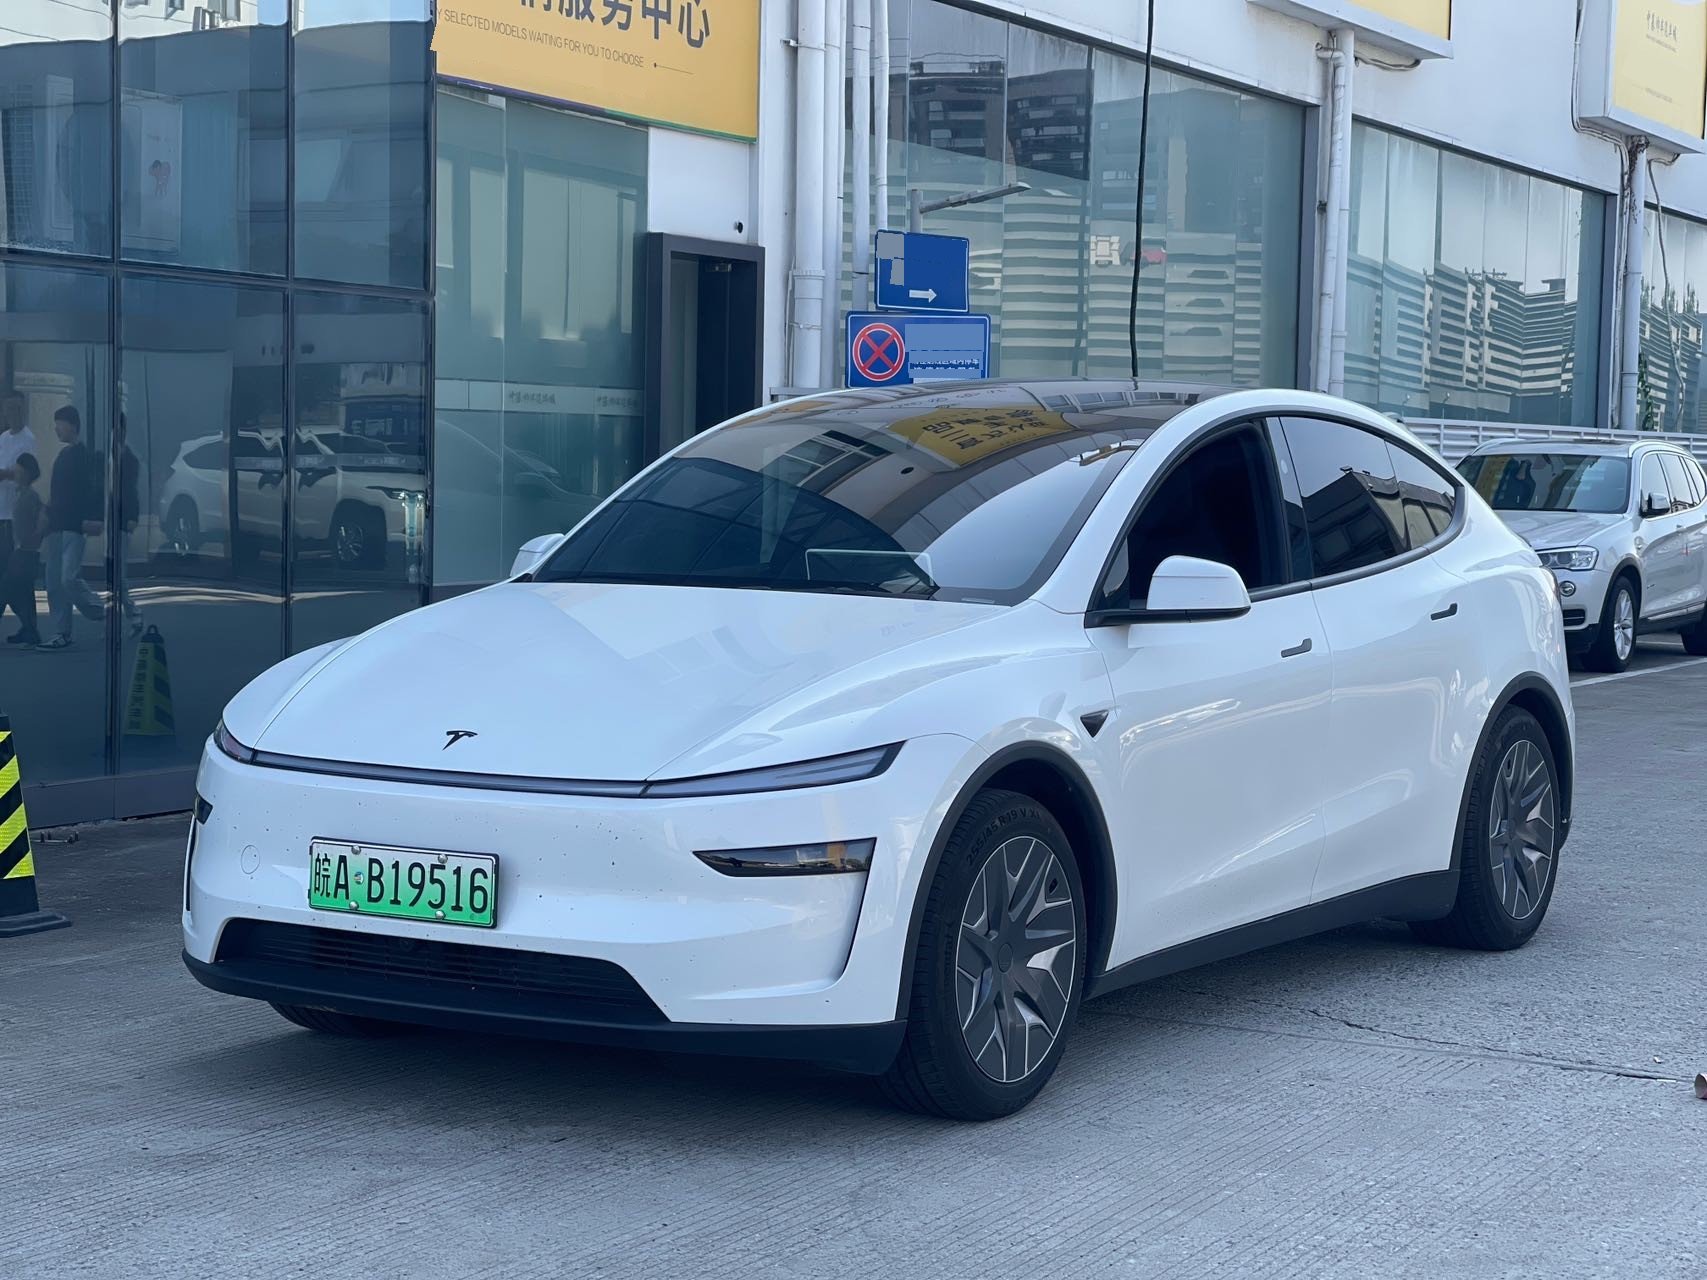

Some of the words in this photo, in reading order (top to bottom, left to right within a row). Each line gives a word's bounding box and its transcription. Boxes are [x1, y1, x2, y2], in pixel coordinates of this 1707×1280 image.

[444, 9, 490, 31] SELECTED
[491, 20, 528, 41] MODELS
[529, 30, 563, 48] WAITING
[564, 38, 581, 52] FOR
[582, 43, 599, 57] YOU
[601, 47, 612, 60] TO
[612, 50, 644, 67] CHOOSE
[519, 0, 710, 48] 务中心
